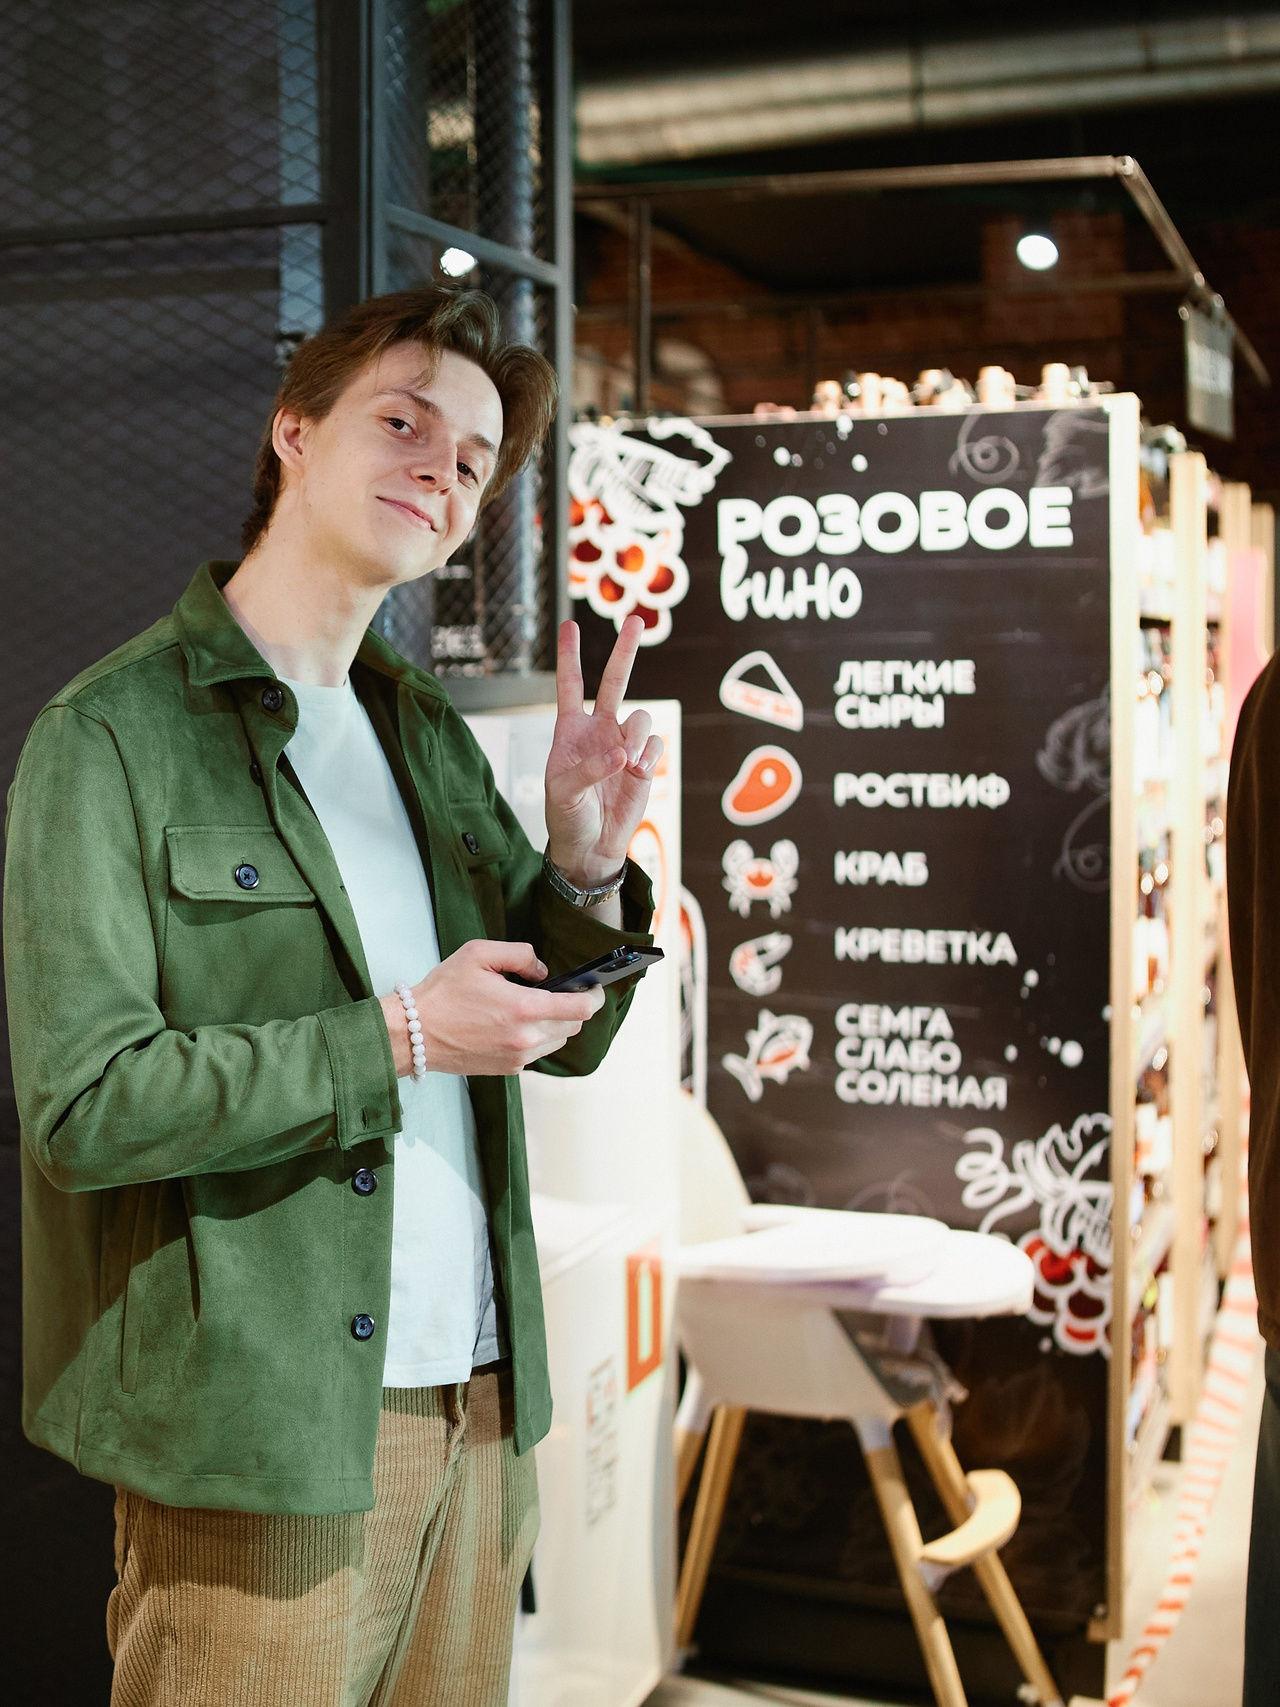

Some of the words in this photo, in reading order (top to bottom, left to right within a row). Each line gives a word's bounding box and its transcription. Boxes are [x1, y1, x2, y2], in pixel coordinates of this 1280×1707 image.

[717, 486, 1073, 556] РОЗОВОЕ
[833, 659, 976, 695] ЛЕГКИЕ
[834, 693, 945, 729] СЫРЫ
[834, 772, 1011, 809] РОСТБИФ
[834, 850, 929, 886] КРАБ
[834, 926, 1018, 965] КРЕВЕТКА
[835, 1003, 954, 1040] СЕМГА
[835, 1036, 962, 1075] СЛАБО
[835, 1069, 1008, 1110] СОЛЕНАЯ
